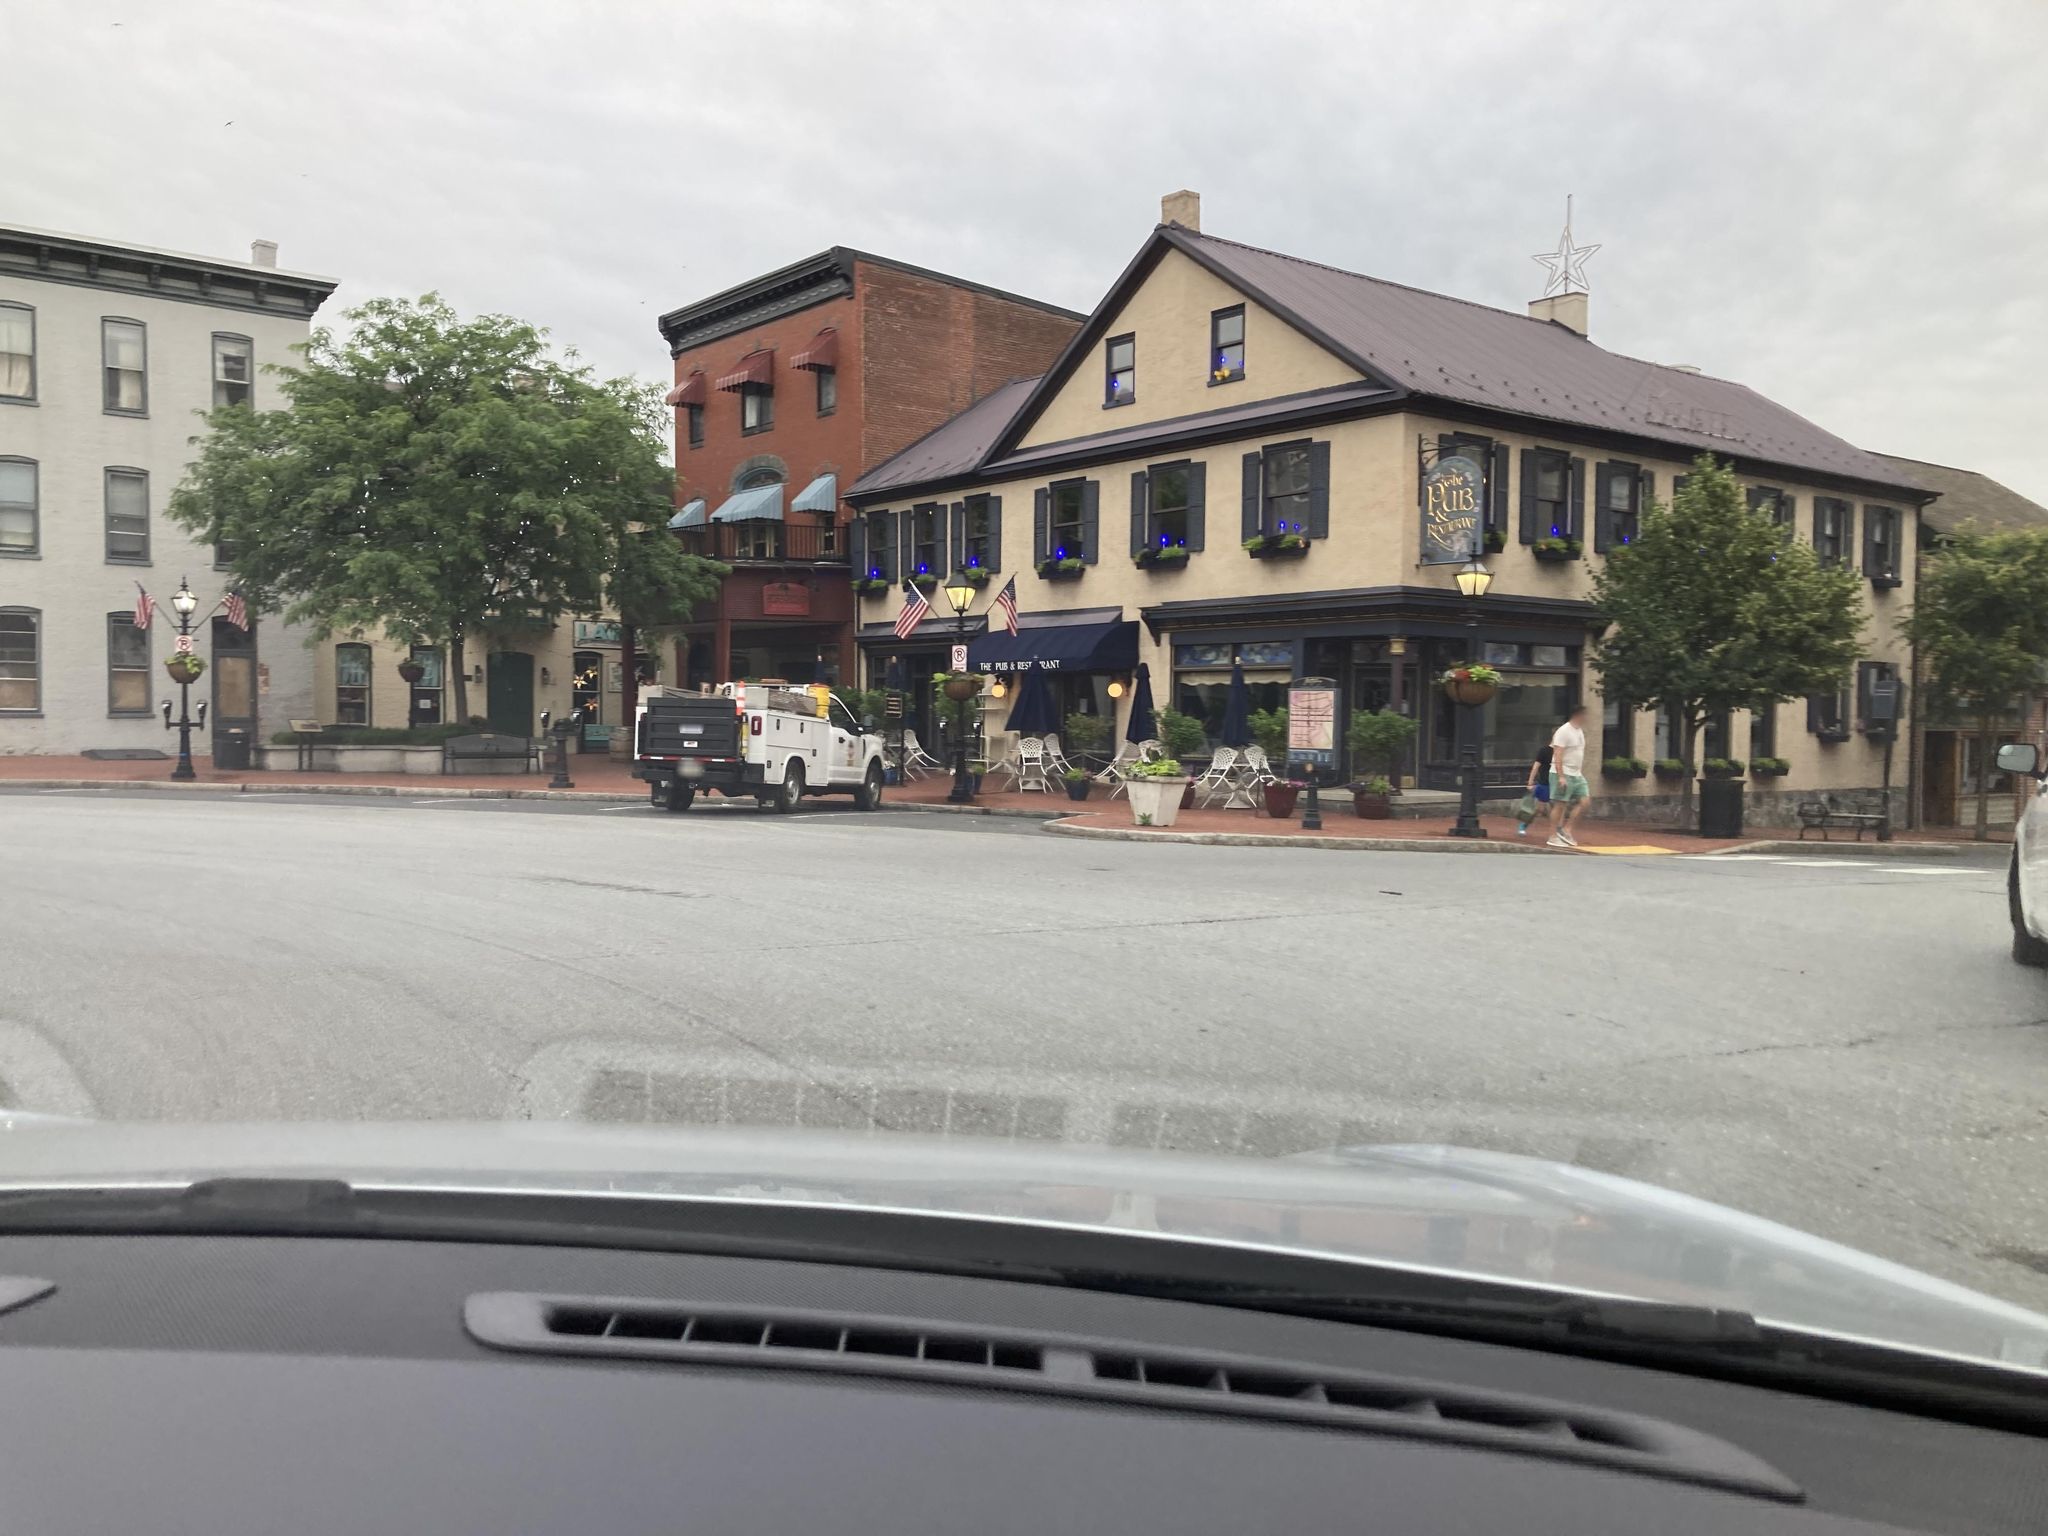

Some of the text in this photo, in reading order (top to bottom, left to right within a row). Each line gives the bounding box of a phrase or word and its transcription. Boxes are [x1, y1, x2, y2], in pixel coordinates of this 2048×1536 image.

[980, 660, 1060, 671] THE PUB & RESTRANT
